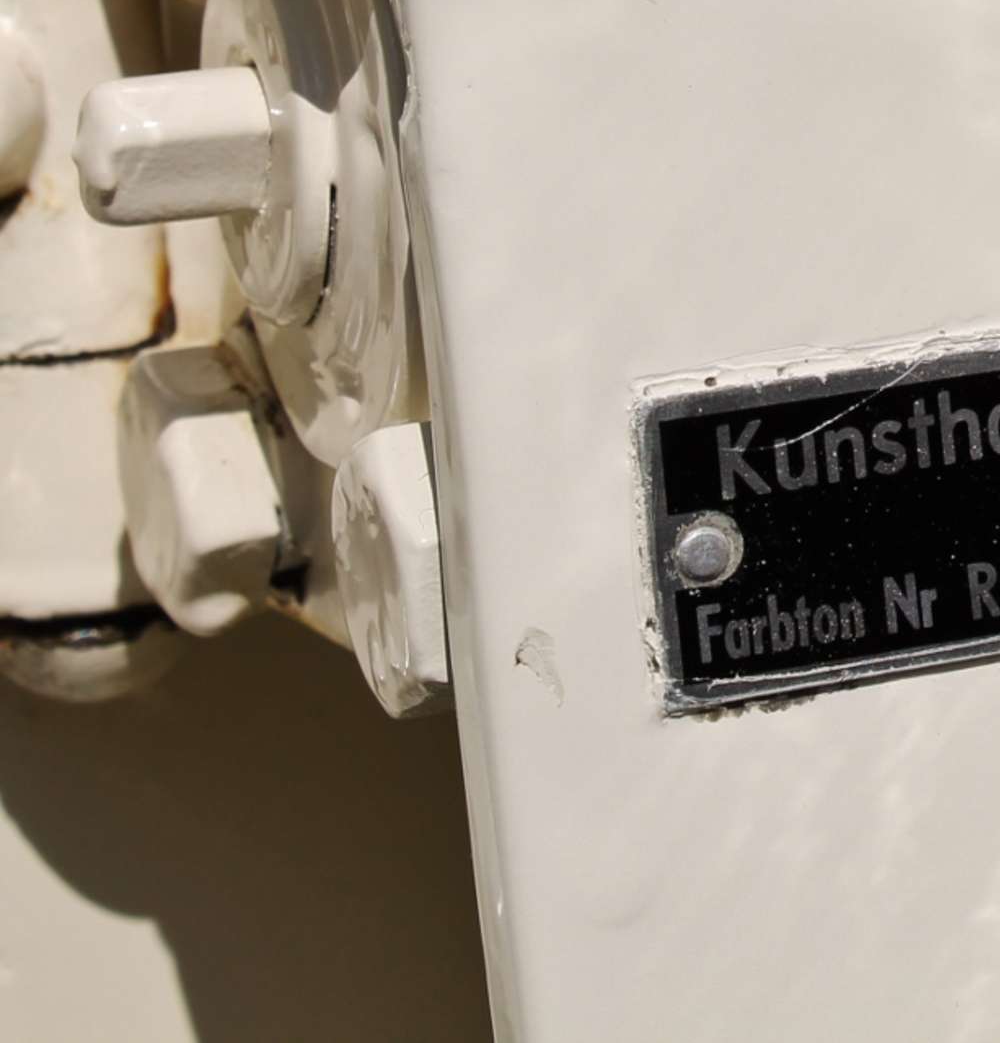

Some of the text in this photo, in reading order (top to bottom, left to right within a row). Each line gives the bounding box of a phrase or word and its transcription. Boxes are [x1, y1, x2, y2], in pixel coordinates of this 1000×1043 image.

[696, 597, 866, 663] Farbton
[884, 574, 938, 634] Nr
[968, 561, 1000, 618] R
